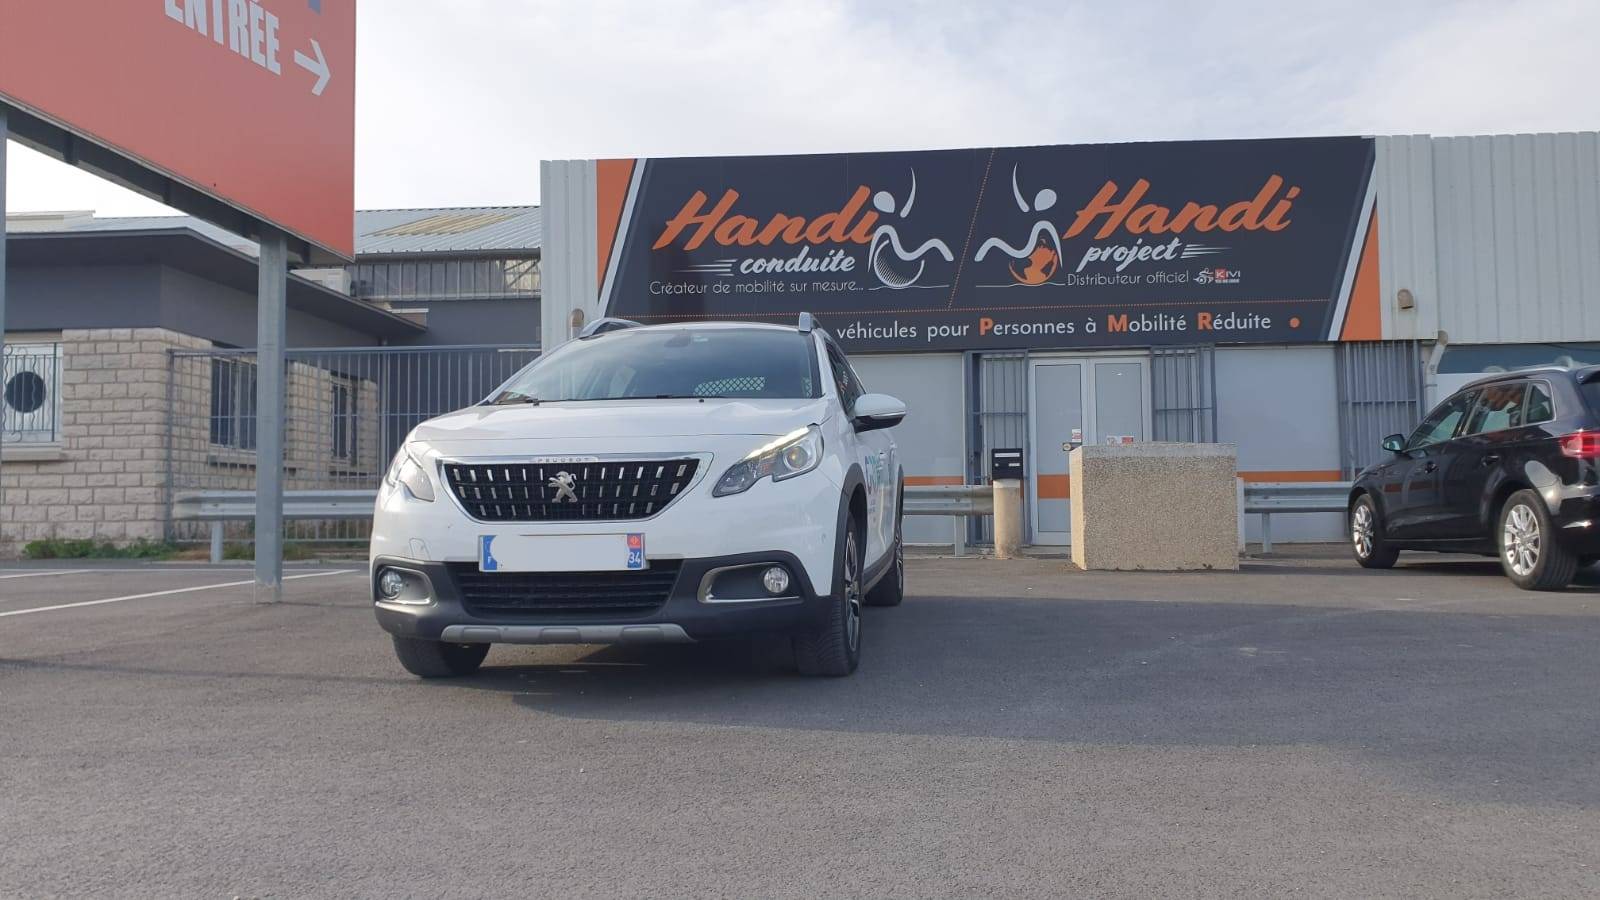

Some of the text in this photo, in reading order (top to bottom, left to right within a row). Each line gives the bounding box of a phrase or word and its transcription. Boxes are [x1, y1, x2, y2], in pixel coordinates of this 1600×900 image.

[652, 185, 880, 251] Handi
[1062, 174, 1301, 240] Handi
[739, 246, 856, 274] conduite
[1076, 237, 1182, 272] project
[649, 279, 864, 295] Créateur de mobilité sur mesure...
[1067, 269, 1190, 286] Distributeur officiel
[836, 311, 1271, 343] véhicules pour Personnes à Mobilité Réduite
[628, 552, 641, 564] 34
